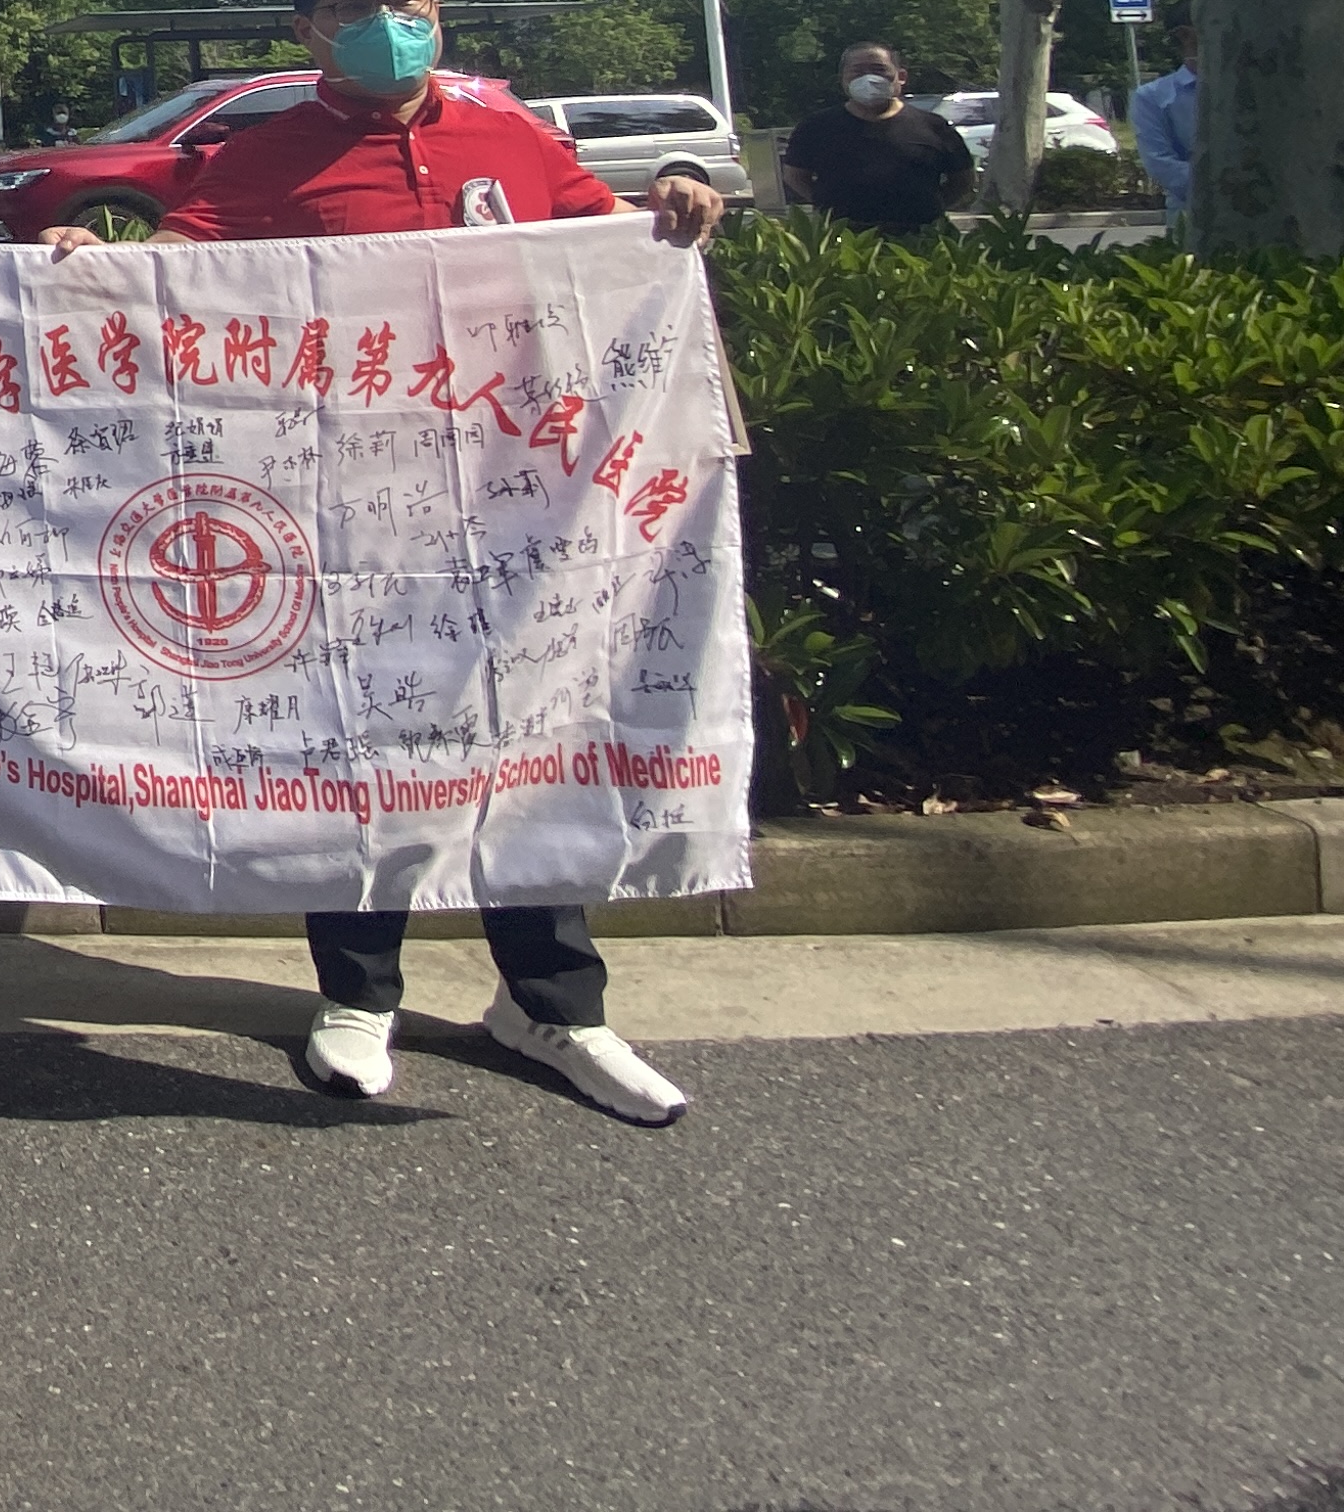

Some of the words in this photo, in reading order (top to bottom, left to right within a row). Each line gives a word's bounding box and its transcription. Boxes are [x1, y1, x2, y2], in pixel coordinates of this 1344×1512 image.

[376, 765, 492, 813] University
[495, 743, 565, 793] School
[572, 741, 600, 786] of
[605, 743, 721, 789] Medicine
